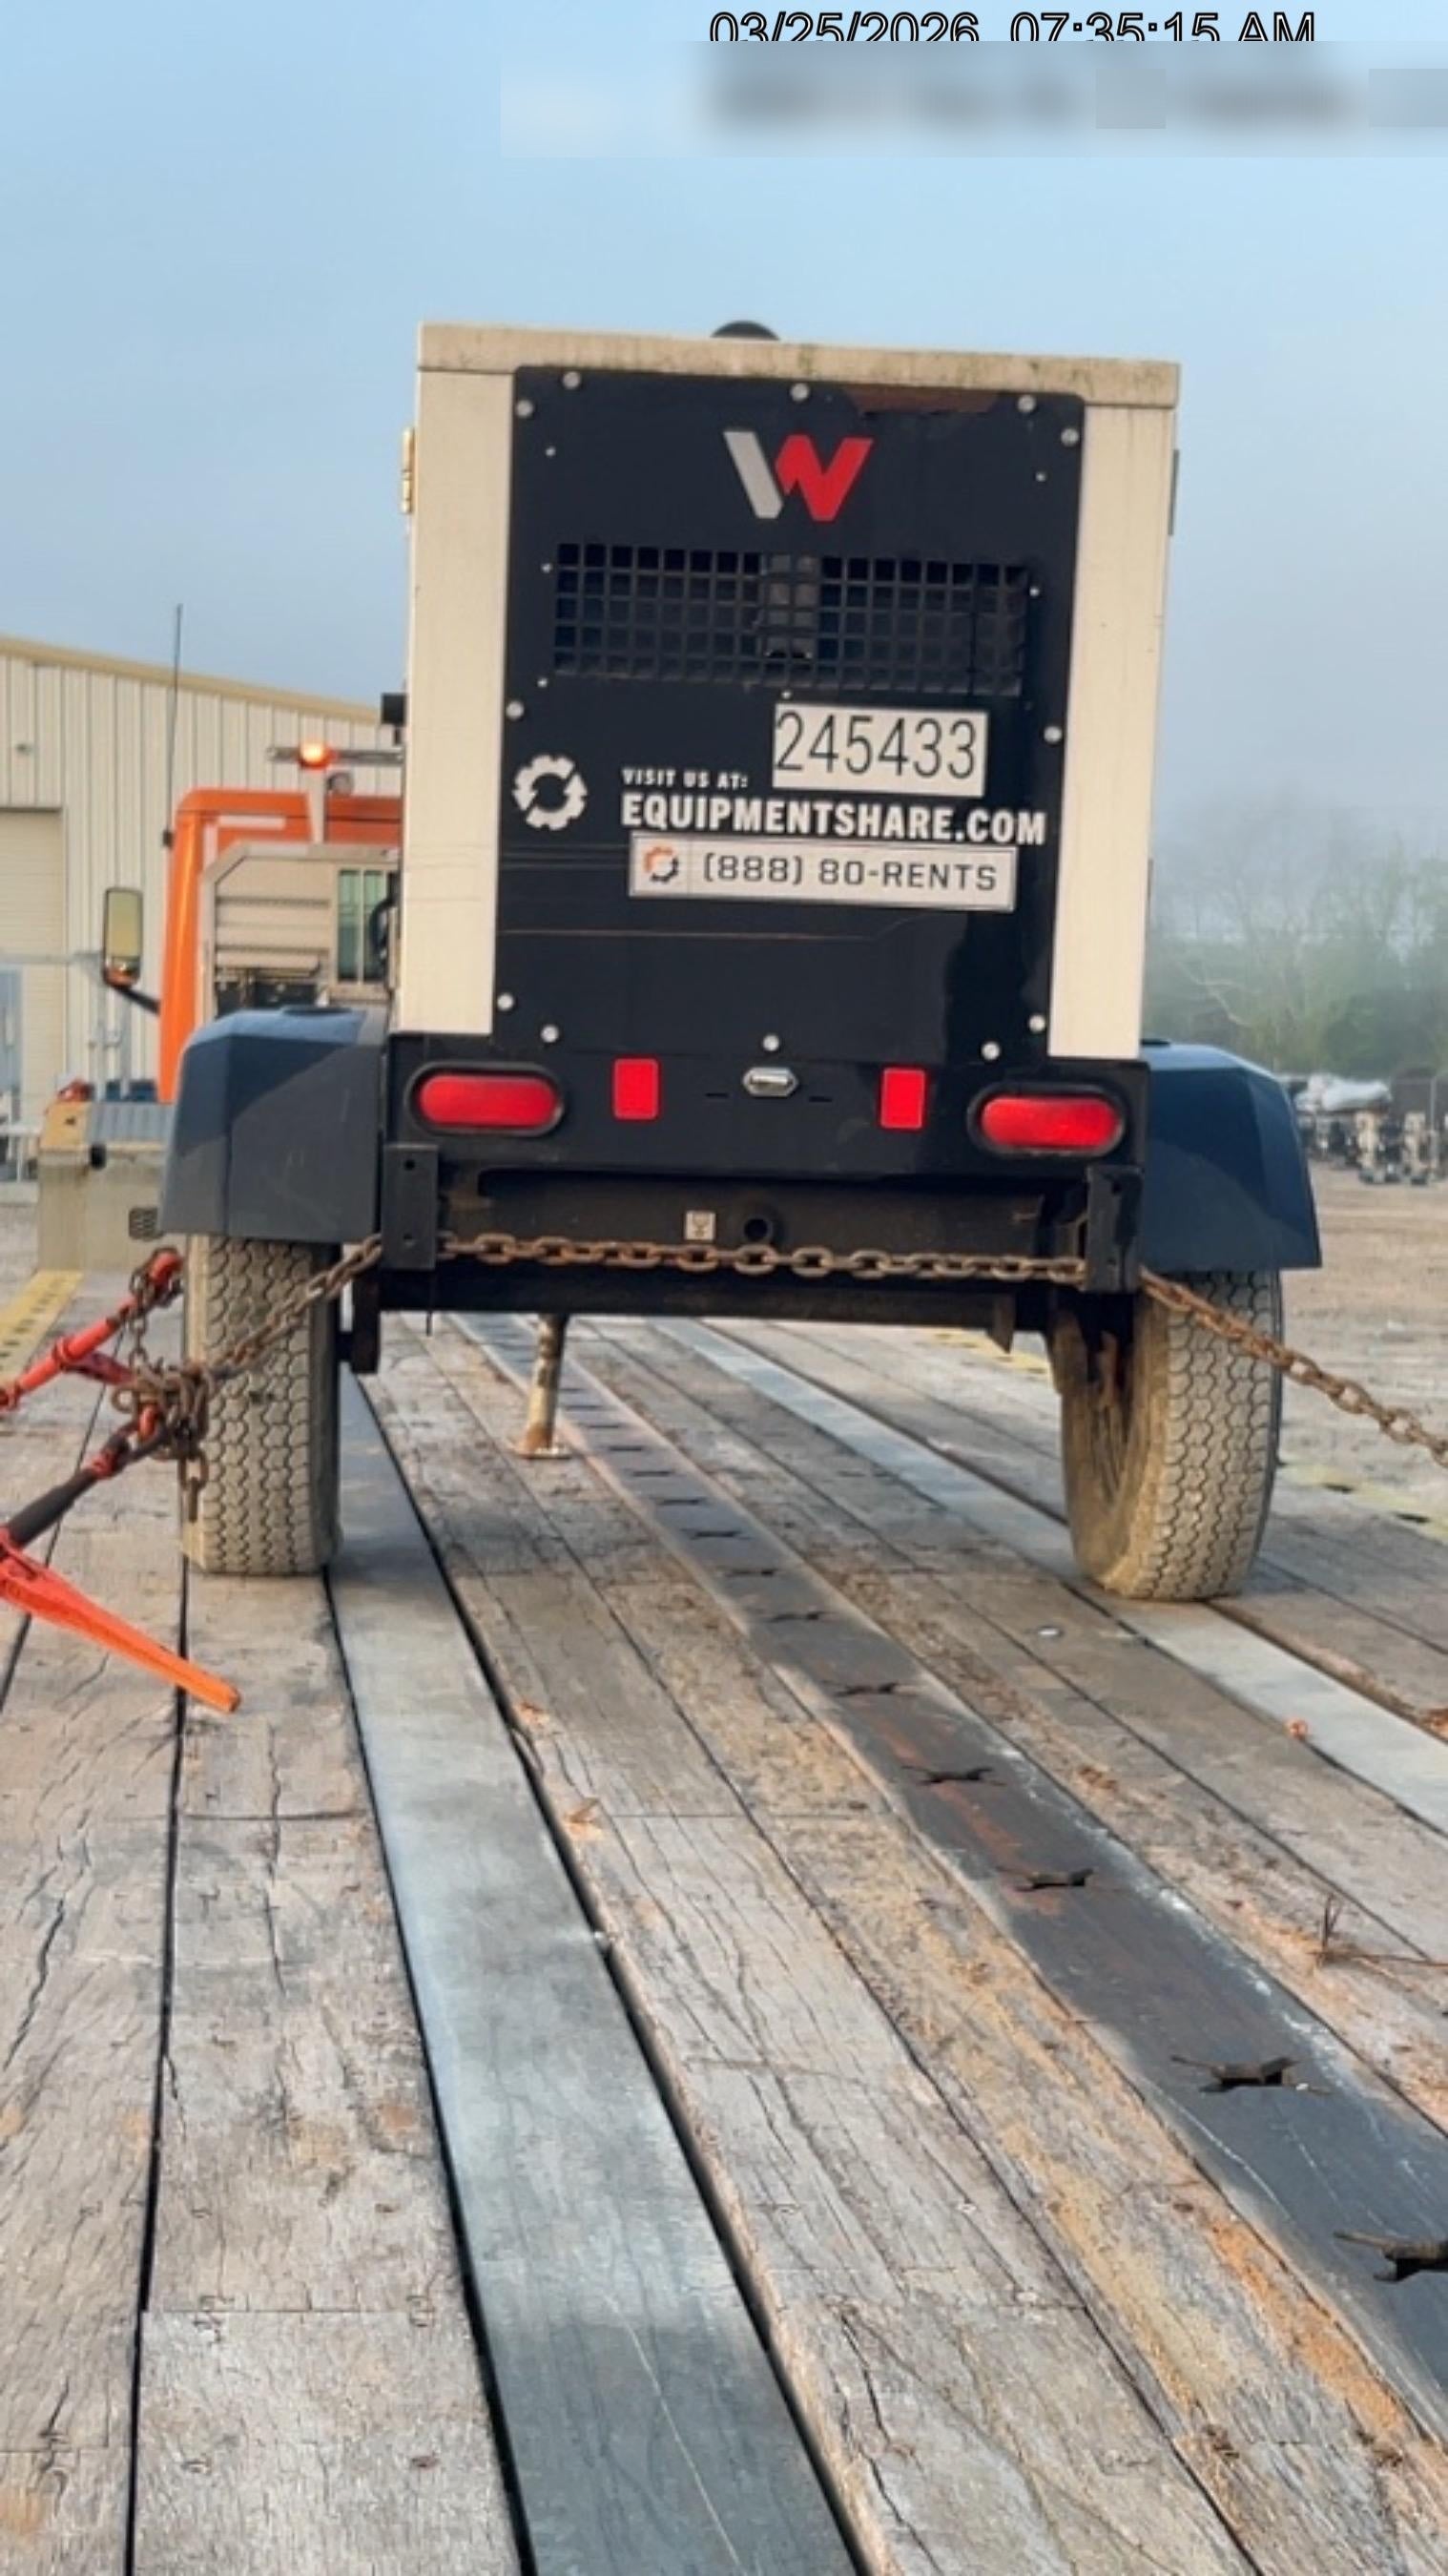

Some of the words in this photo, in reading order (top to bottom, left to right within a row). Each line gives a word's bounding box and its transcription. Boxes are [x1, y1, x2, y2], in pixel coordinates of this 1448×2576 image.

[776, 712, 977, 779] 245433
[622, 768, 675, 786] VISIT
[683, 770, 710, 788] US
[717, 772, 749, 789] AT:
[621, 793, 1046, 845] EQUIPMENTSHARE.COM
[703, 853, 803, 883] (888)
[818, 859, 997, 891] 80-RENTS
